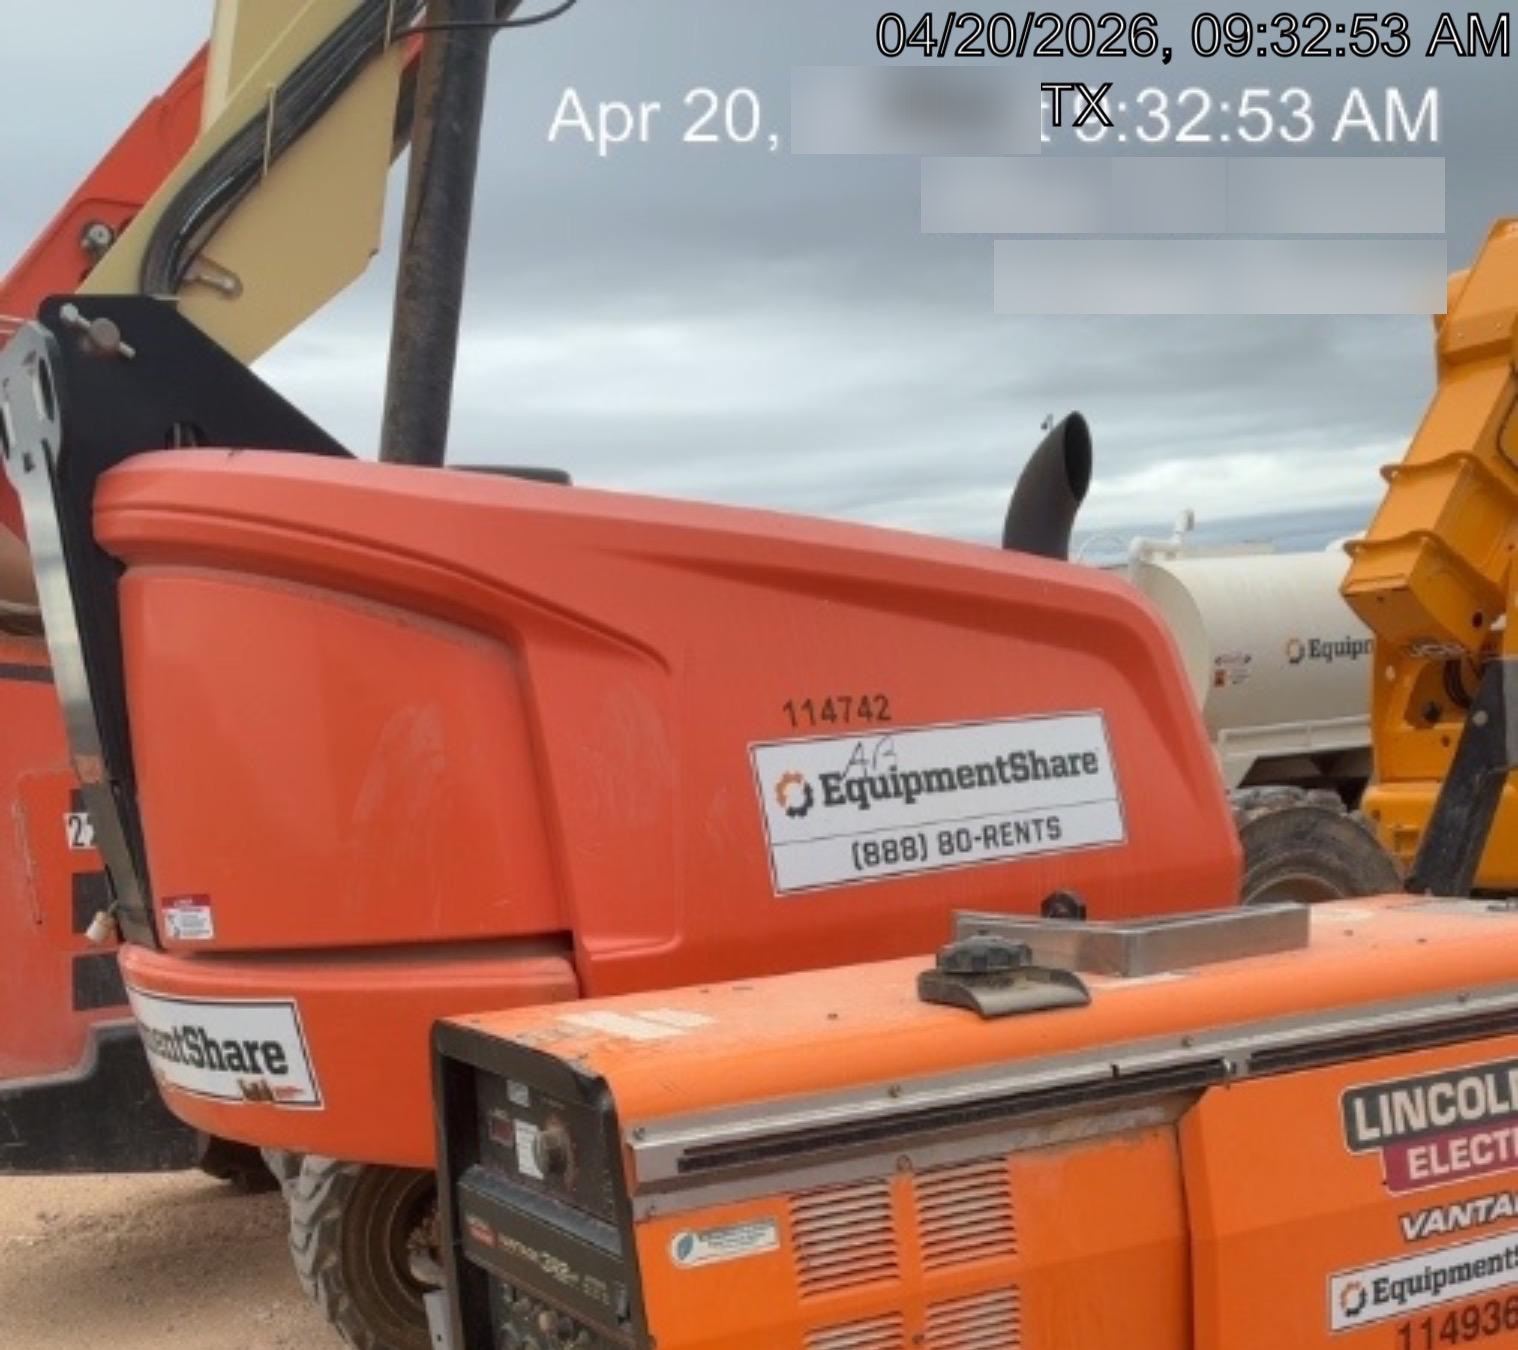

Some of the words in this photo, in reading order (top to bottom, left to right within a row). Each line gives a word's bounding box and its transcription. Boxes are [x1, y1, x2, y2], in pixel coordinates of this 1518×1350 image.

[783, 695, 892, 726] 114742
[818, 750, 1099, 809] EquipmentShare
[851, 834, 928, 869] (888)
[937, 816, 1062, 856] 80-RENTS
[1400, 1196, 1518, 1242] VANTA
[1372, 1243, 1518, 1306] Equipment
